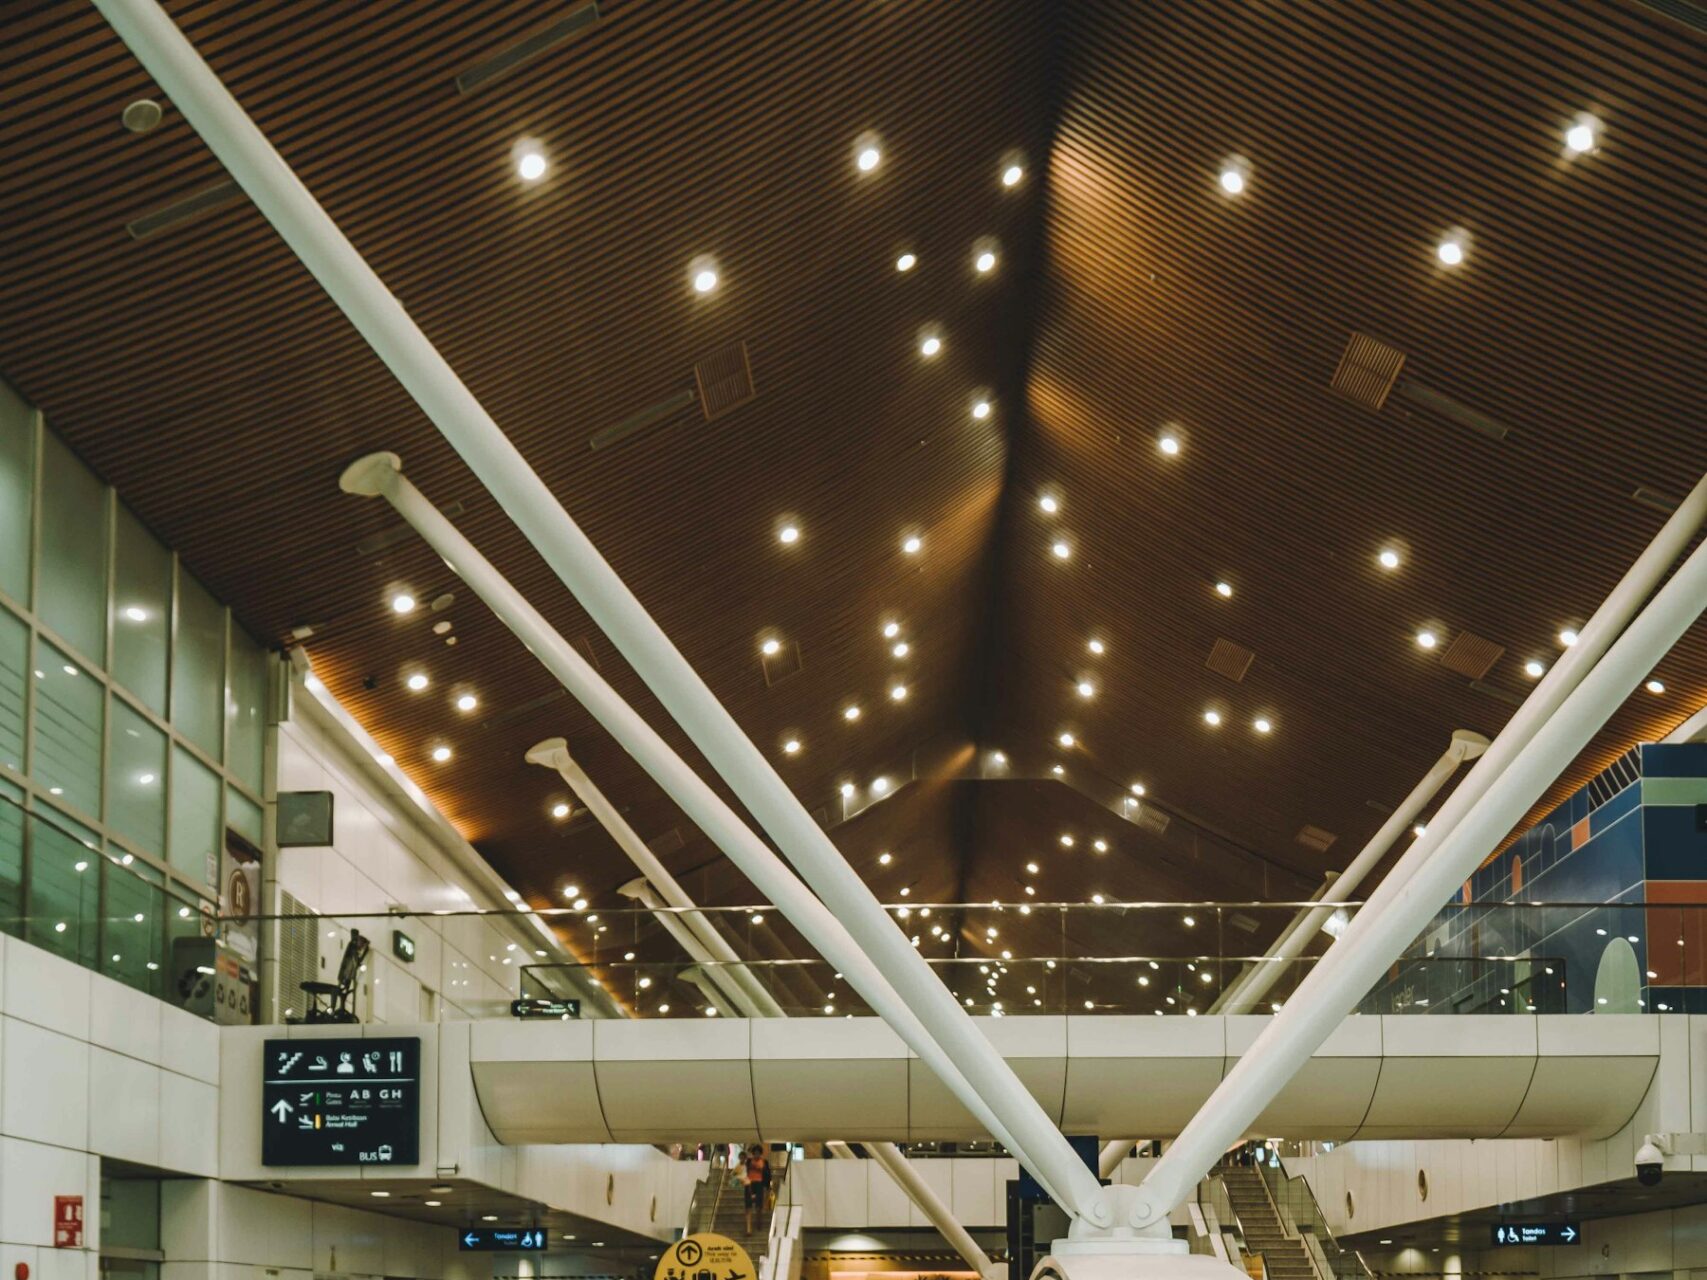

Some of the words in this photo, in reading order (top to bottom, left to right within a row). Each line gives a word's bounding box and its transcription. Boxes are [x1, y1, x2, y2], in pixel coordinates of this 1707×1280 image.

[235, 880, 244, 908] R
[350, 1089, 359, 1099] A
[362, 1089, 371, 1099] B
[379, 1089, 389, 1099] G
[391, 1089, 402, 1099] H
[331, 1142, 344, 1151] via
[359, 1152, 377, 1161] BUS
